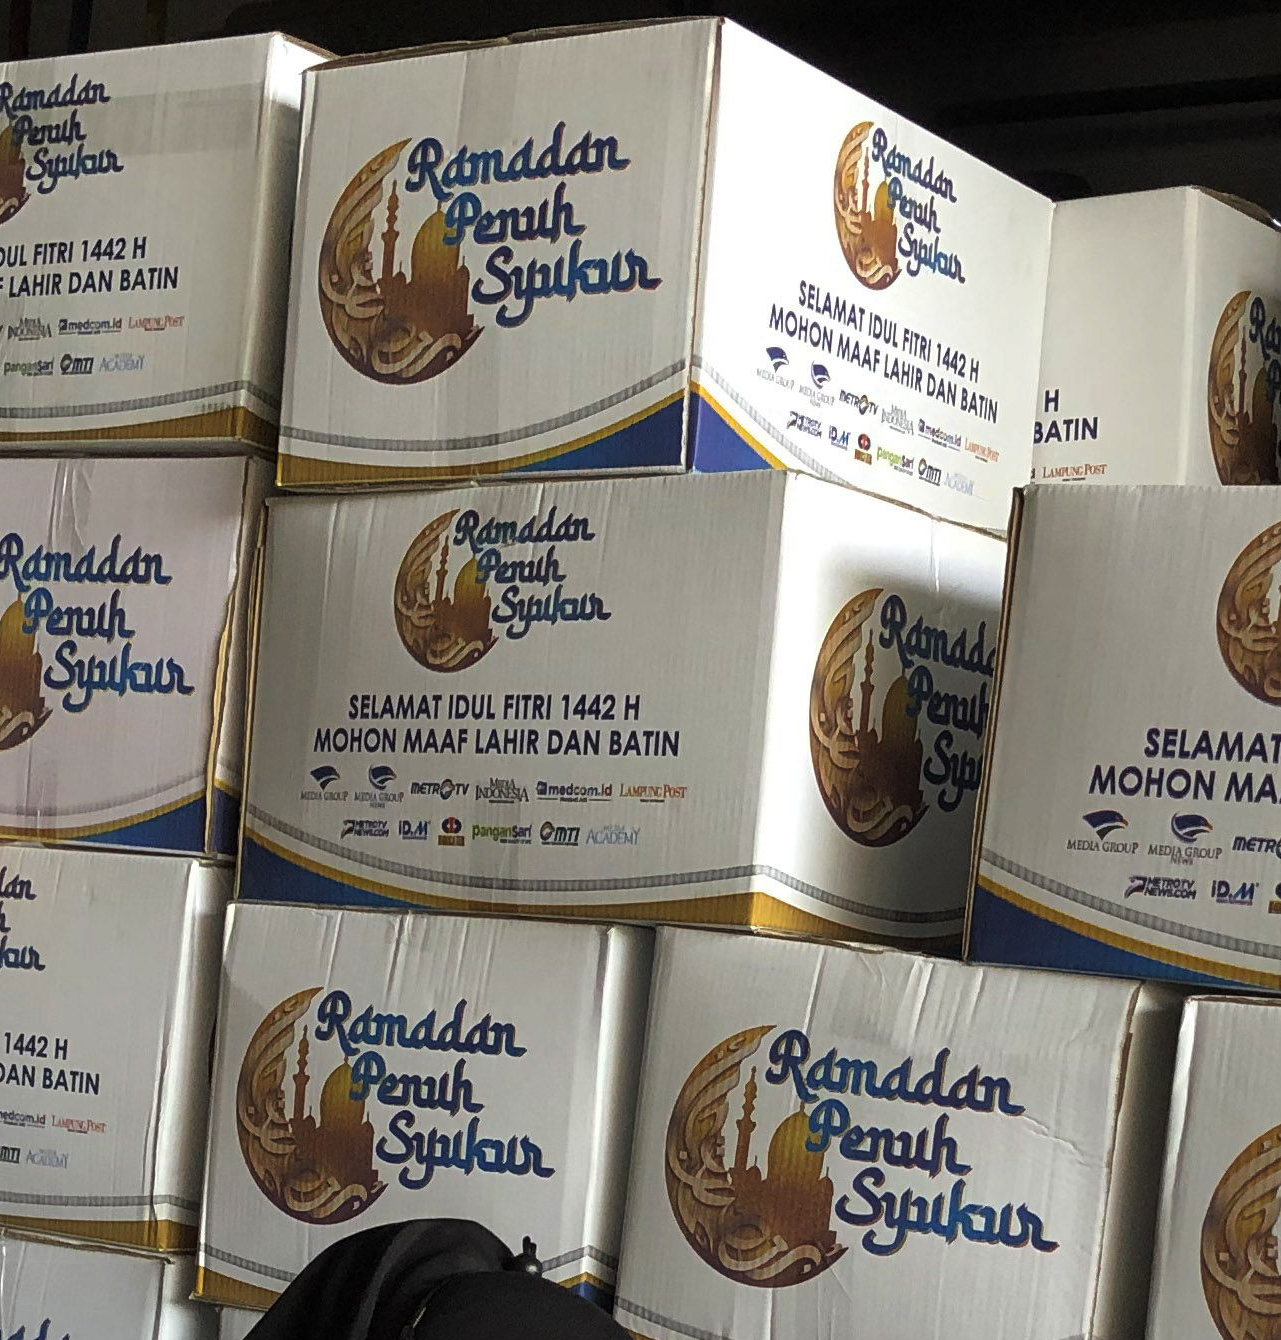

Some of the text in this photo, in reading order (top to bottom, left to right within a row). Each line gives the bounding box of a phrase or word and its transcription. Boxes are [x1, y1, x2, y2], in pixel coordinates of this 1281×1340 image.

[13, 109, 87, 146] Penuh
[26, 141, 123, 194] Syukur
[404, 121, 631, 200] Ramadan
[872, 128, 957, 203] Ramadan
[443, 182, 587, 245] Penuh
[887, 176, 941, 234] Penuh
[33, 241, 73, 266] FITRI
[81, 238, 127, 263] 1442
[133, 236, 147, 259] H
[898, 222, 965, 283] Syukur
[9, 274, 62, 298] LAHIR
[68, 269, 114, 294] DAN
[119, 266, 179, 291] BATIN
[471, 239, 664, 328] Syukur
[799, 280, 980, 384] SELAMAT IDUL FITRI 1442 H
[769, 304, 998, 424] MOHON MAAF LAHIR DAN BATIN
[1044, 389, 1059, 412] H
[1034, 417, 1098, 444] BATIN
[1085, 464, 1107, 475] POST
[453, 505, 595, 554] Ramadan
[475, 546, 566, 584] Penuh
[22, 587, 135, 643] Penuh
[492, 583, 611, 639] Syukur
[43, 639, 195, 713] Syukur
[348, 694, 640, 721] SELAMAT IDUL FITRI 1442 H
[313, 728, 680, 757] MOHON MAAF LAHIR DAN BATIN
[1089, 766, 1215, 801] MOHON
[3, 1031, 48, 1058] 1442
[54, 1037, 68, 1061] H
[315, 990, 527, 1057] Ramadan
[42, 1069, 100, 1095] BATIN
[350, 1050, 485, 1117] Penuh
[765, 1028, 1025, 1116] Ramadan
[376, 1109, 556, 1190] Syukur
[805, 1098, 971, 1178] Penuh
[835, 1166, 1060, 1256] Syukur
